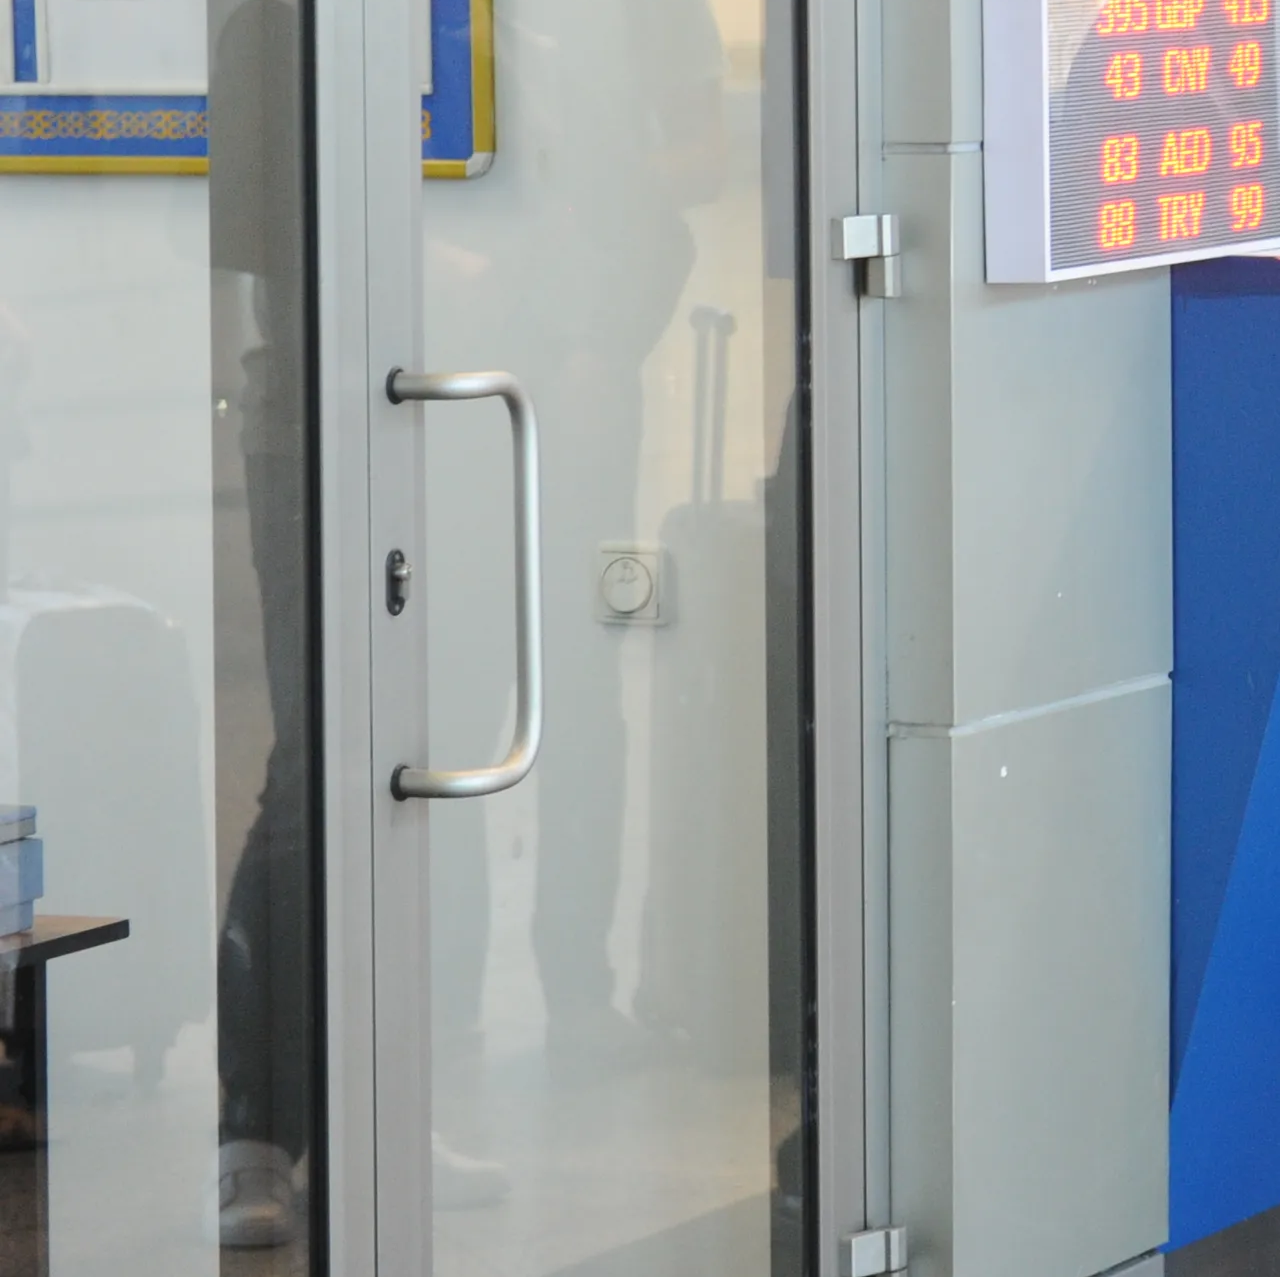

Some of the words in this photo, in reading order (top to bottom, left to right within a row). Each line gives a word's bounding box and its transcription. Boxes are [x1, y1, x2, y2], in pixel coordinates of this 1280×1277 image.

[1163, 46, 1212, 94] CNY
[1228, 41, 1262, 87] 49
[1159, 128, 1212, 176] AED
[1098, 199, 1136, 249] 88
[1156, 192, 1206, 240] TRY
[1230, 184, 1264, 231] 99
